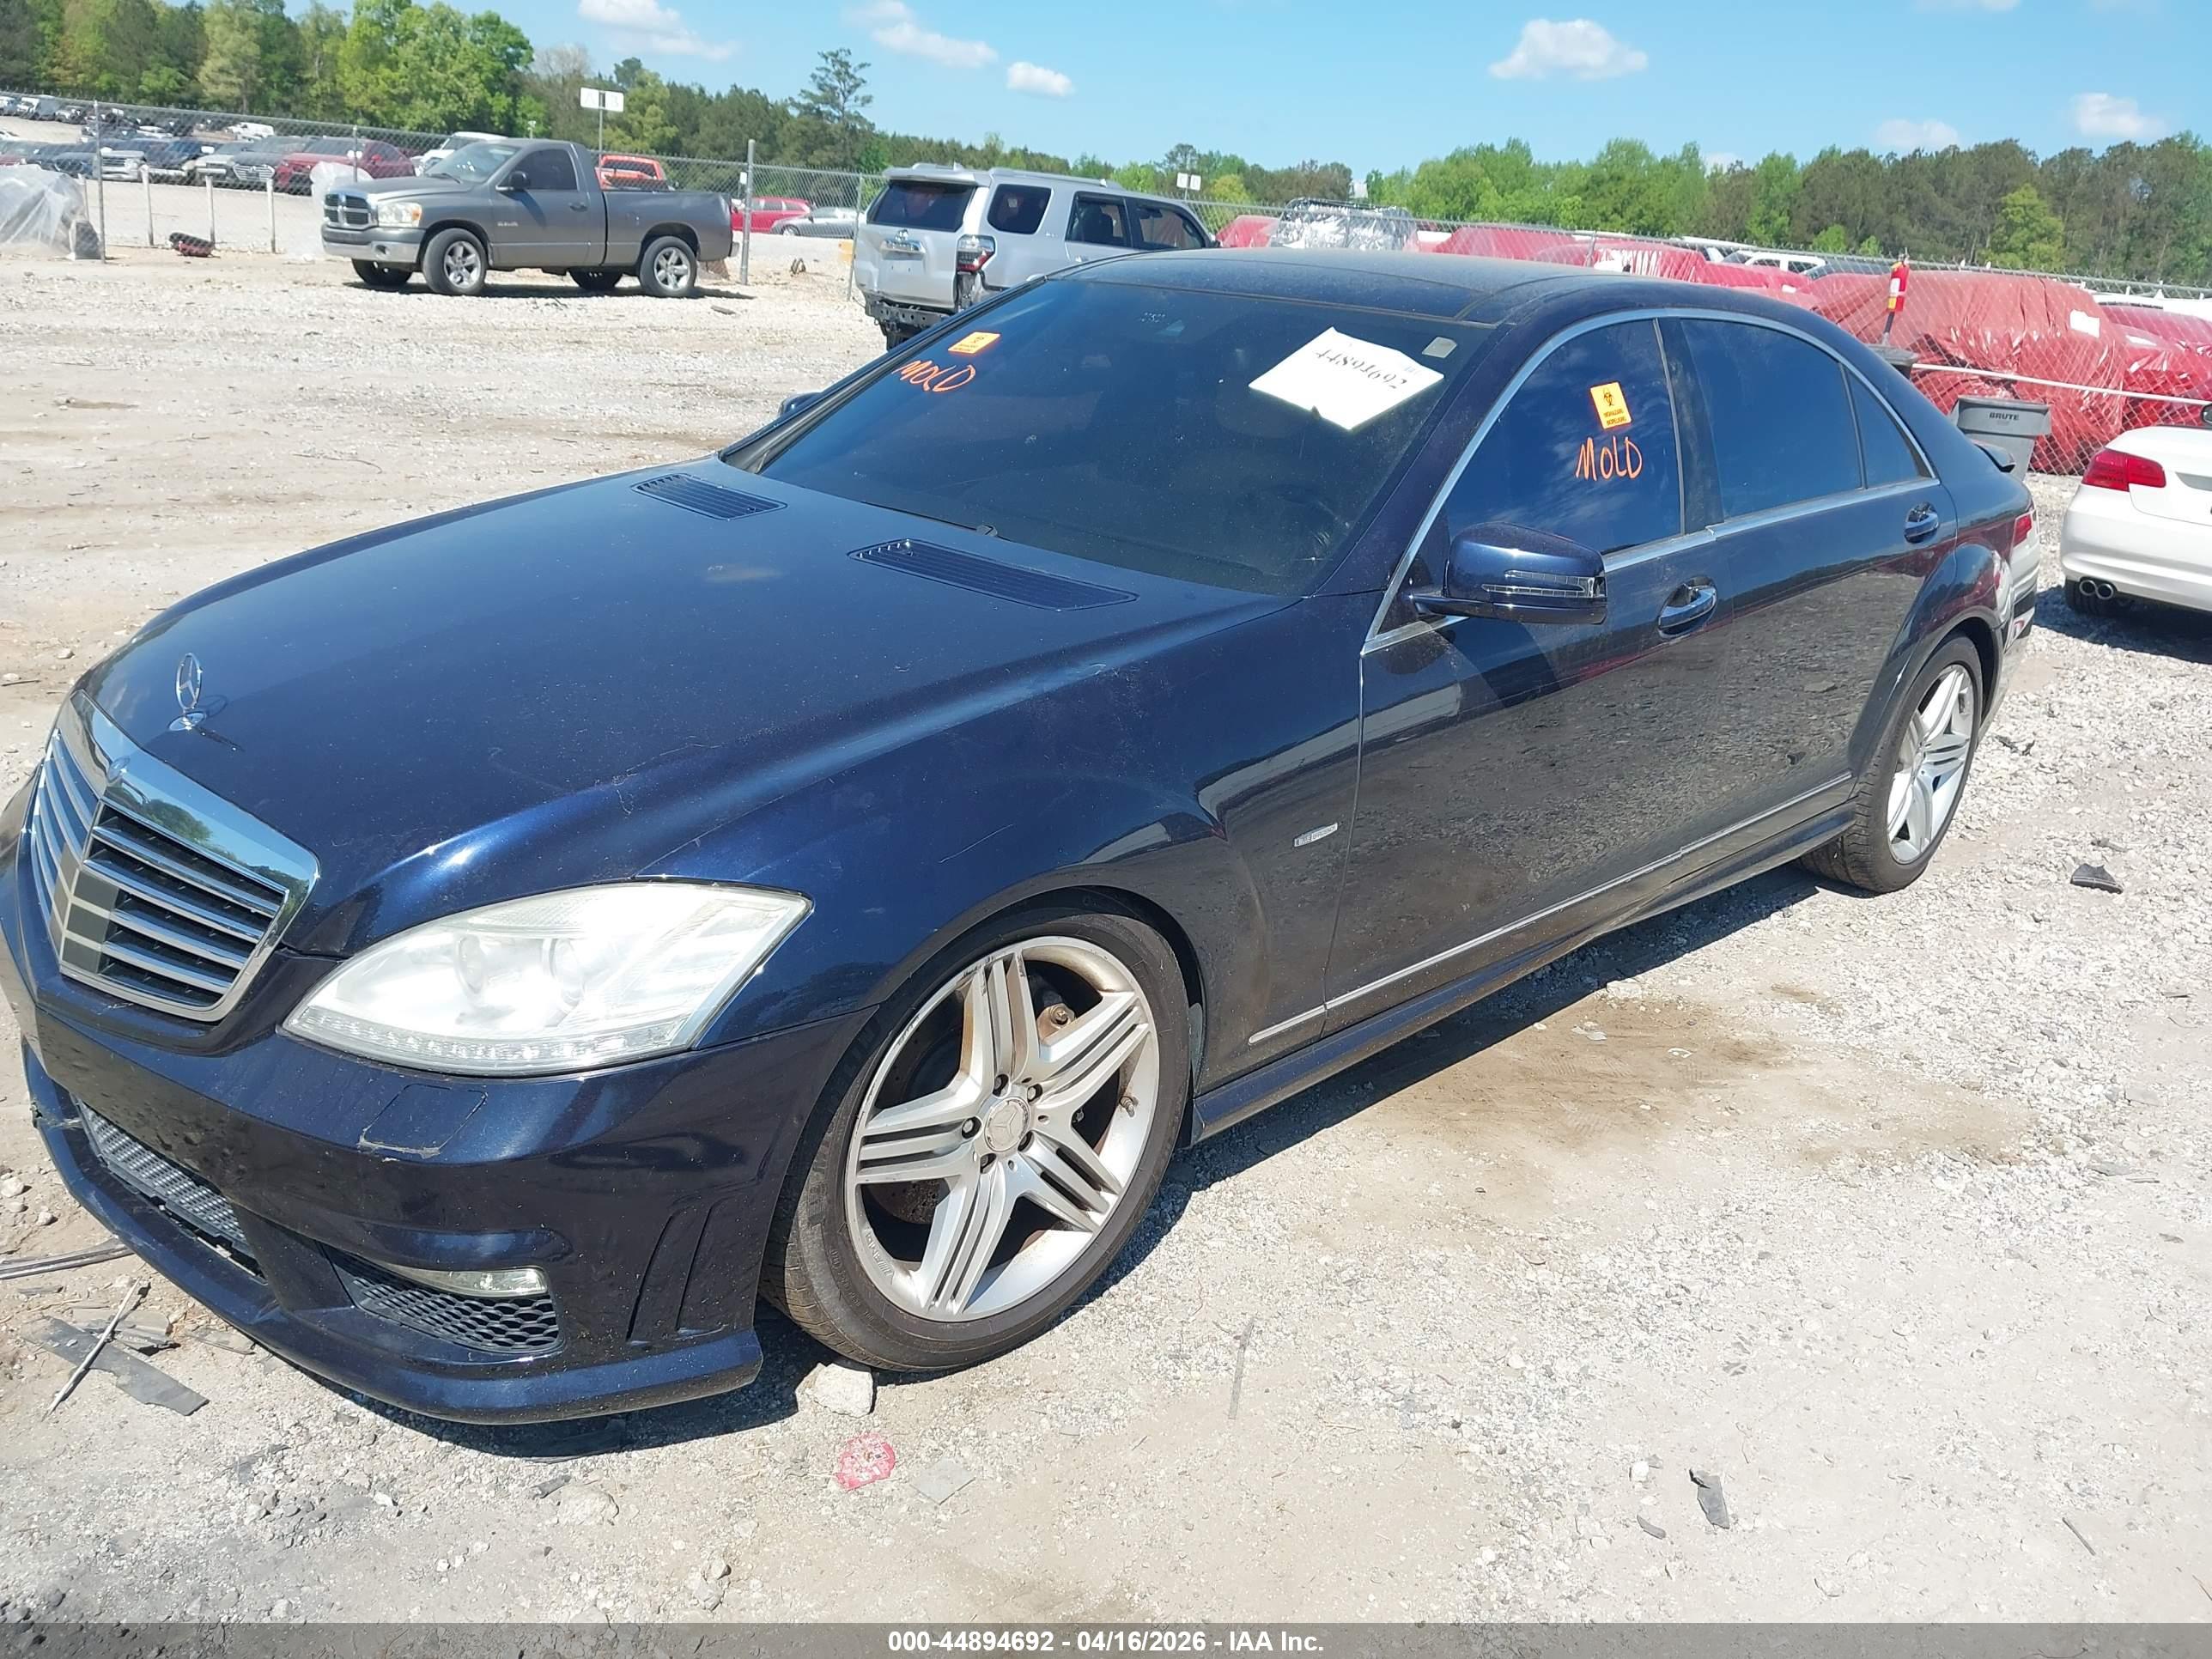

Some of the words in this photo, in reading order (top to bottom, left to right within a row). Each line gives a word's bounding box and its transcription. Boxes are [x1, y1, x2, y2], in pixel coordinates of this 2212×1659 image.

[891, 360, 976, 392] MOLD
[1989, 412, 2019, 421] BRUTE
[1576, 435, 1643, 481] MOLD
